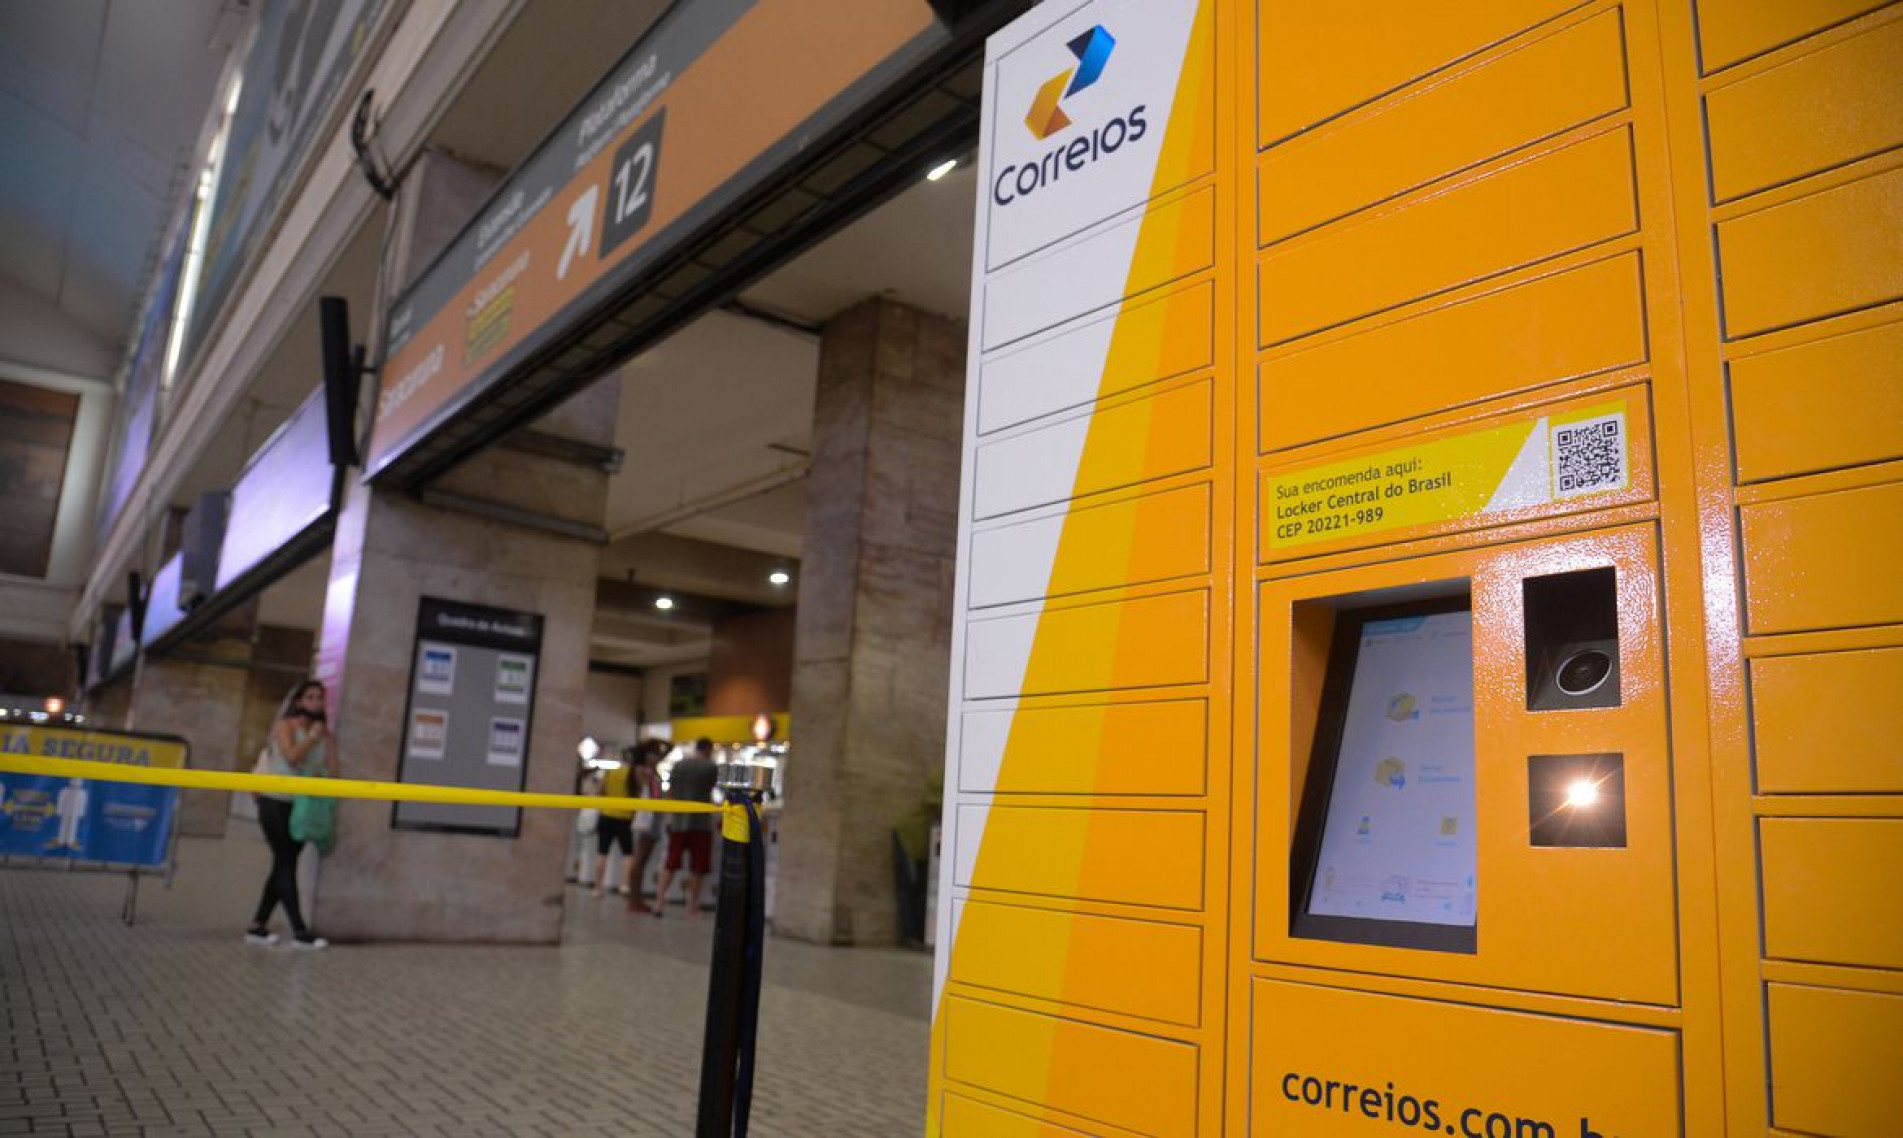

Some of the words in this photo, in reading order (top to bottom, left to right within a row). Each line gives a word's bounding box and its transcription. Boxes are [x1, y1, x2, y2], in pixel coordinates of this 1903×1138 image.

[615, 142, 653, 224] 12
[1276, 485, 1299, 500] Sua
[1303, 466, 1381, 494] encomenda
[1385, 456, 1422, 478] aqui:
[1276, 501, 1323, 519] Locker
[1327, 485, 1380, 510] Central
[1385, 482, 1403, 498] do
[1408, 471, 1452, 494] Brasil
[1276, 522, 1302, 539] CEP
[1308, 506, 1384, 534] 20221-989
[43, 736, 152, 768] SEGURA
[1282, 1072, 1608, 1138] correios.com
